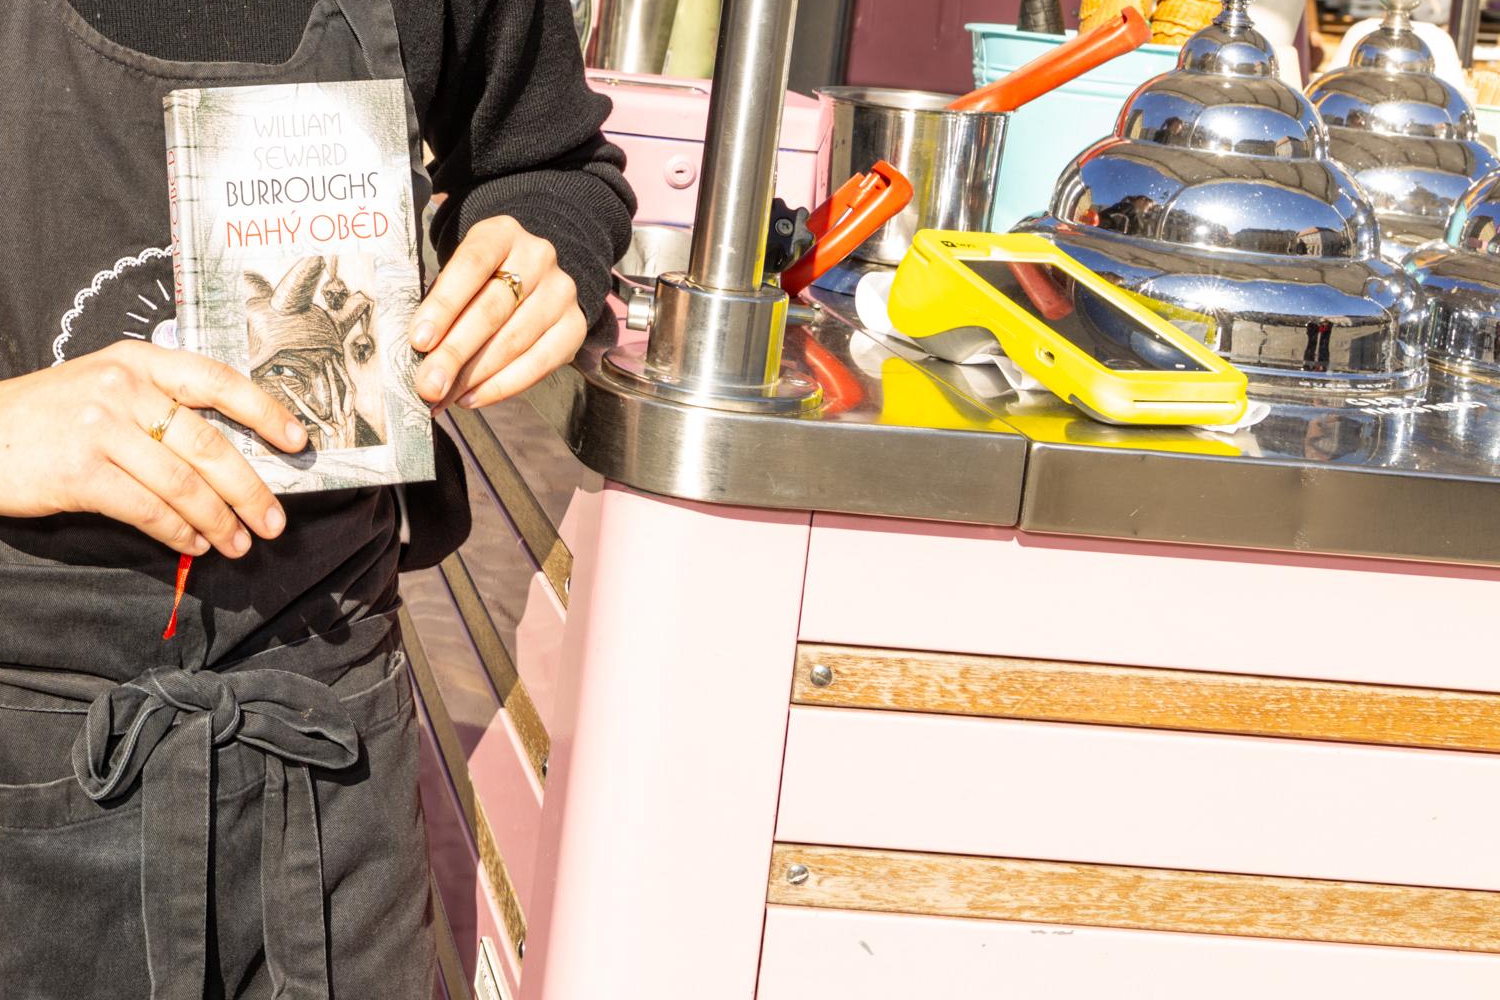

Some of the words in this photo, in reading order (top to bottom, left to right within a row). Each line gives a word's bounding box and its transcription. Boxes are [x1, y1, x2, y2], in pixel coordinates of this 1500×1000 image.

[254, 112, 342, 138] WILLIAM
[253, 143, 347, 170] SEWARD
[226, 171, 378, 207] BURROUGHS
[226, 210, 301, 248] NAHÝ
[309, 205, 389, 242] OBĚD
